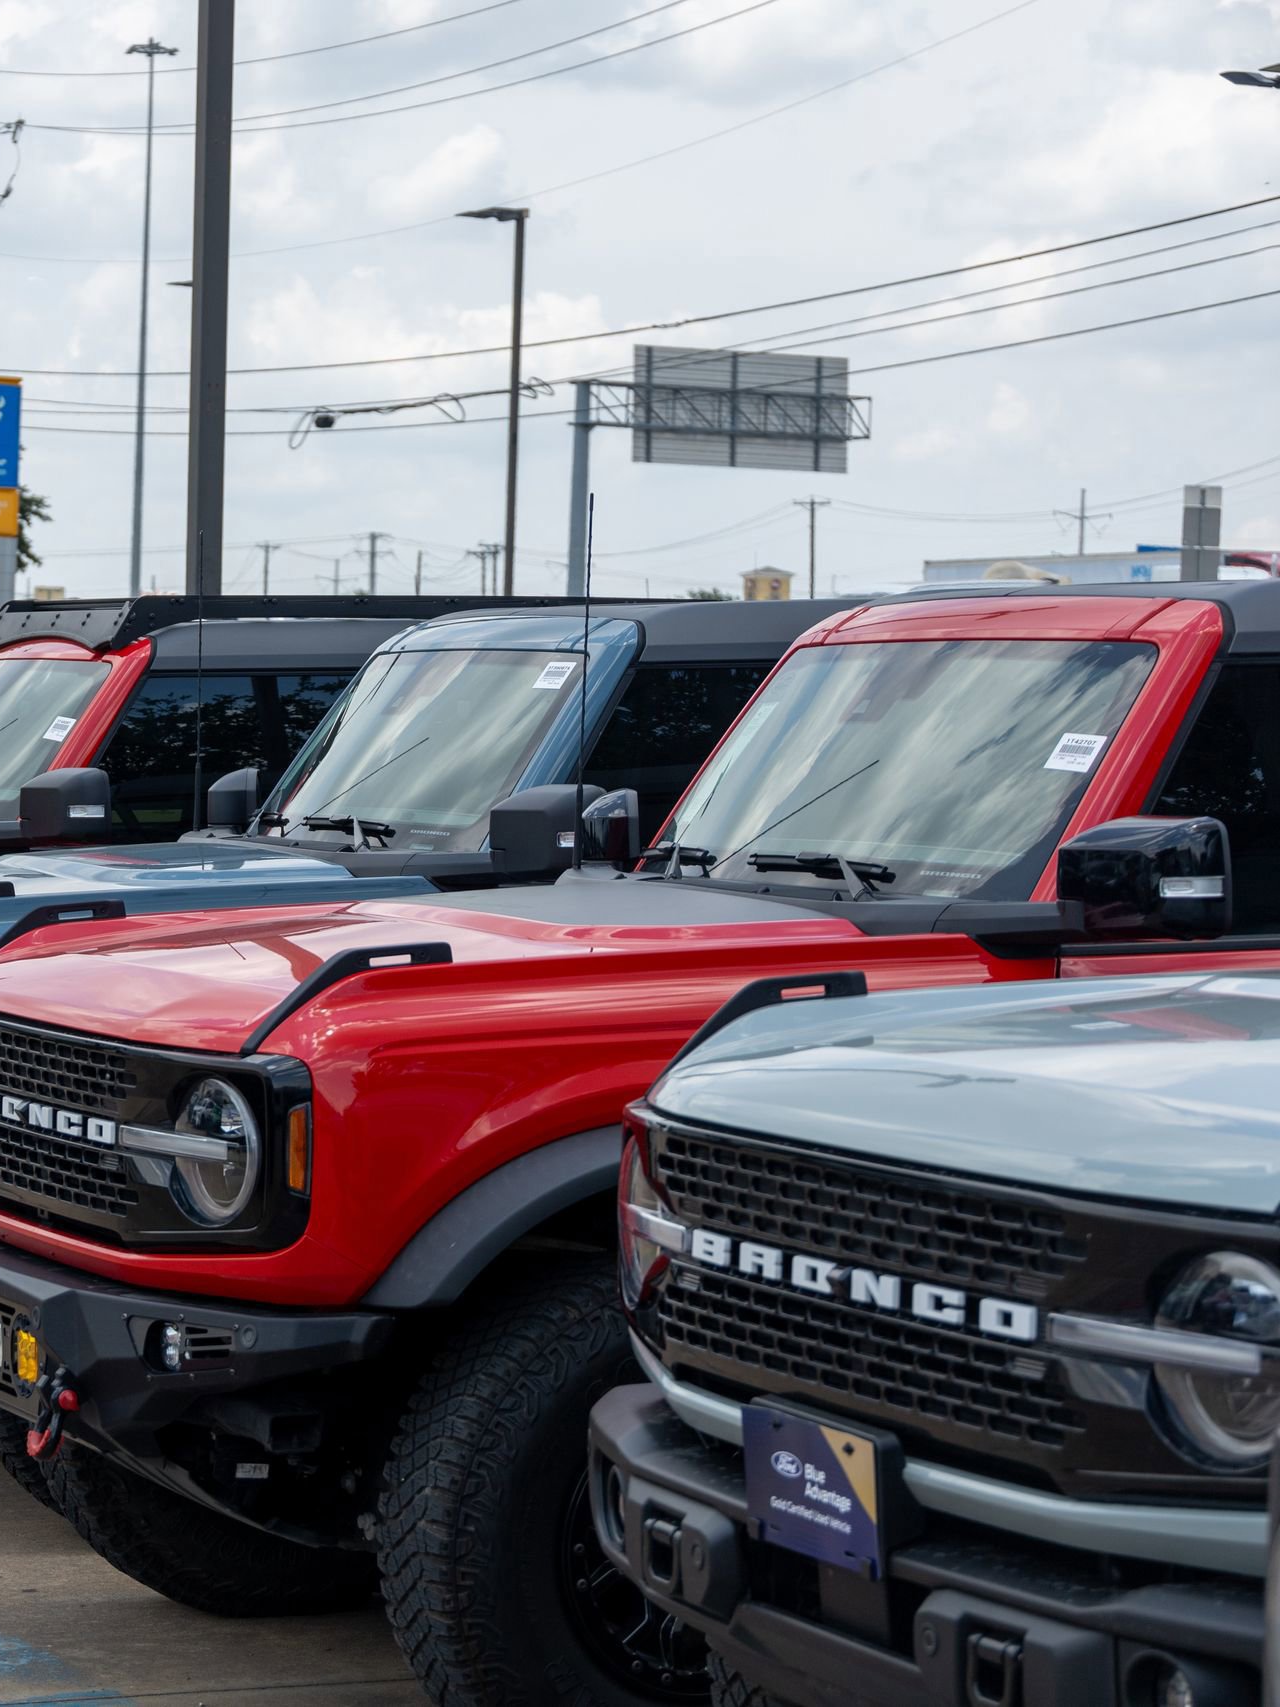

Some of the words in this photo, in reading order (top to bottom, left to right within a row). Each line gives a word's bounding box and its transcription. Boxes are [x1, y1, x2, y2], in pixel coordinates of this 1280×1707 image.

[691, 1228, 1039, 1342] BRONCO
[804, 1463, 826, 1484] Blue
[804, 1481, 852, 1514] Advantage
